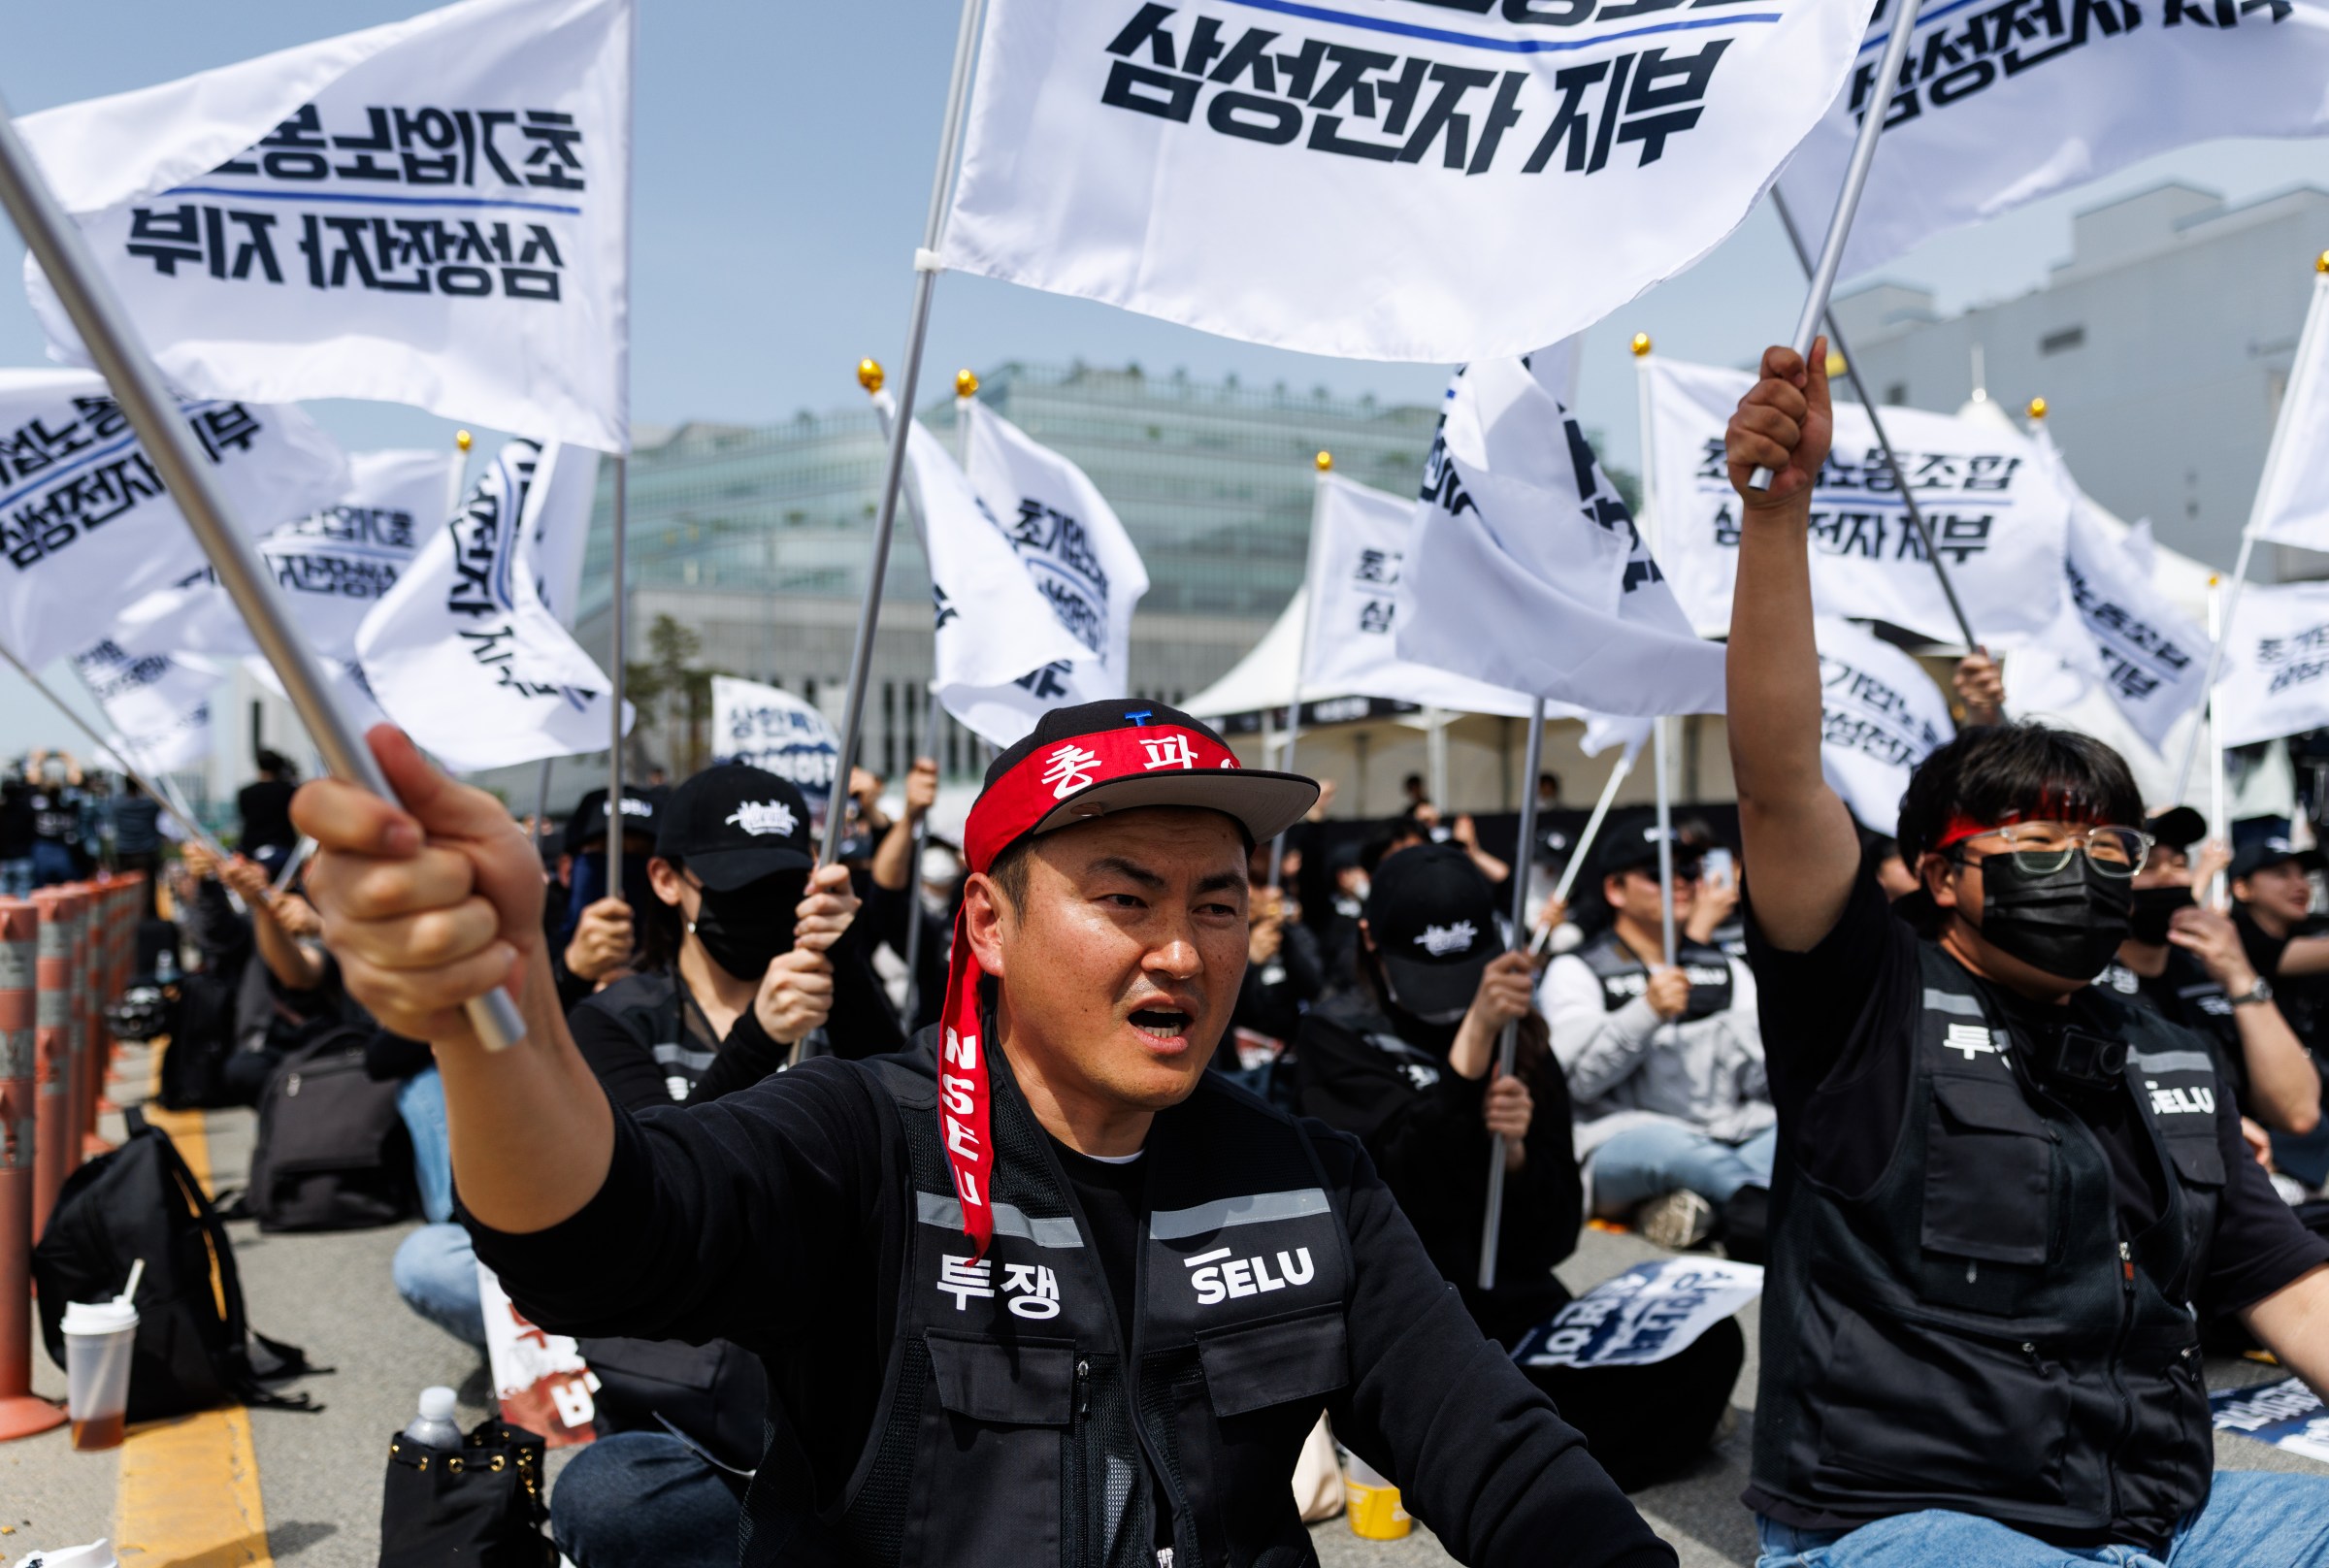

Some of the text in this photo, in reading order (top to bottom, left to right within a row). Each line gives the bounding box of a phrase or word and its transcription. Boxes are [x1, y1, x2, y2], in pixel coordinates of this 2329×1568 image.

[1101, 2, 1733, 177] 삼성전자 지부
[1895, 513, 1993, 565] 지부
[1943, 1022, 2012, 1071] 투
[936, 1254, 1061, 1320] 투쟁
[1184, 1247, 1315, 1305] SELU
